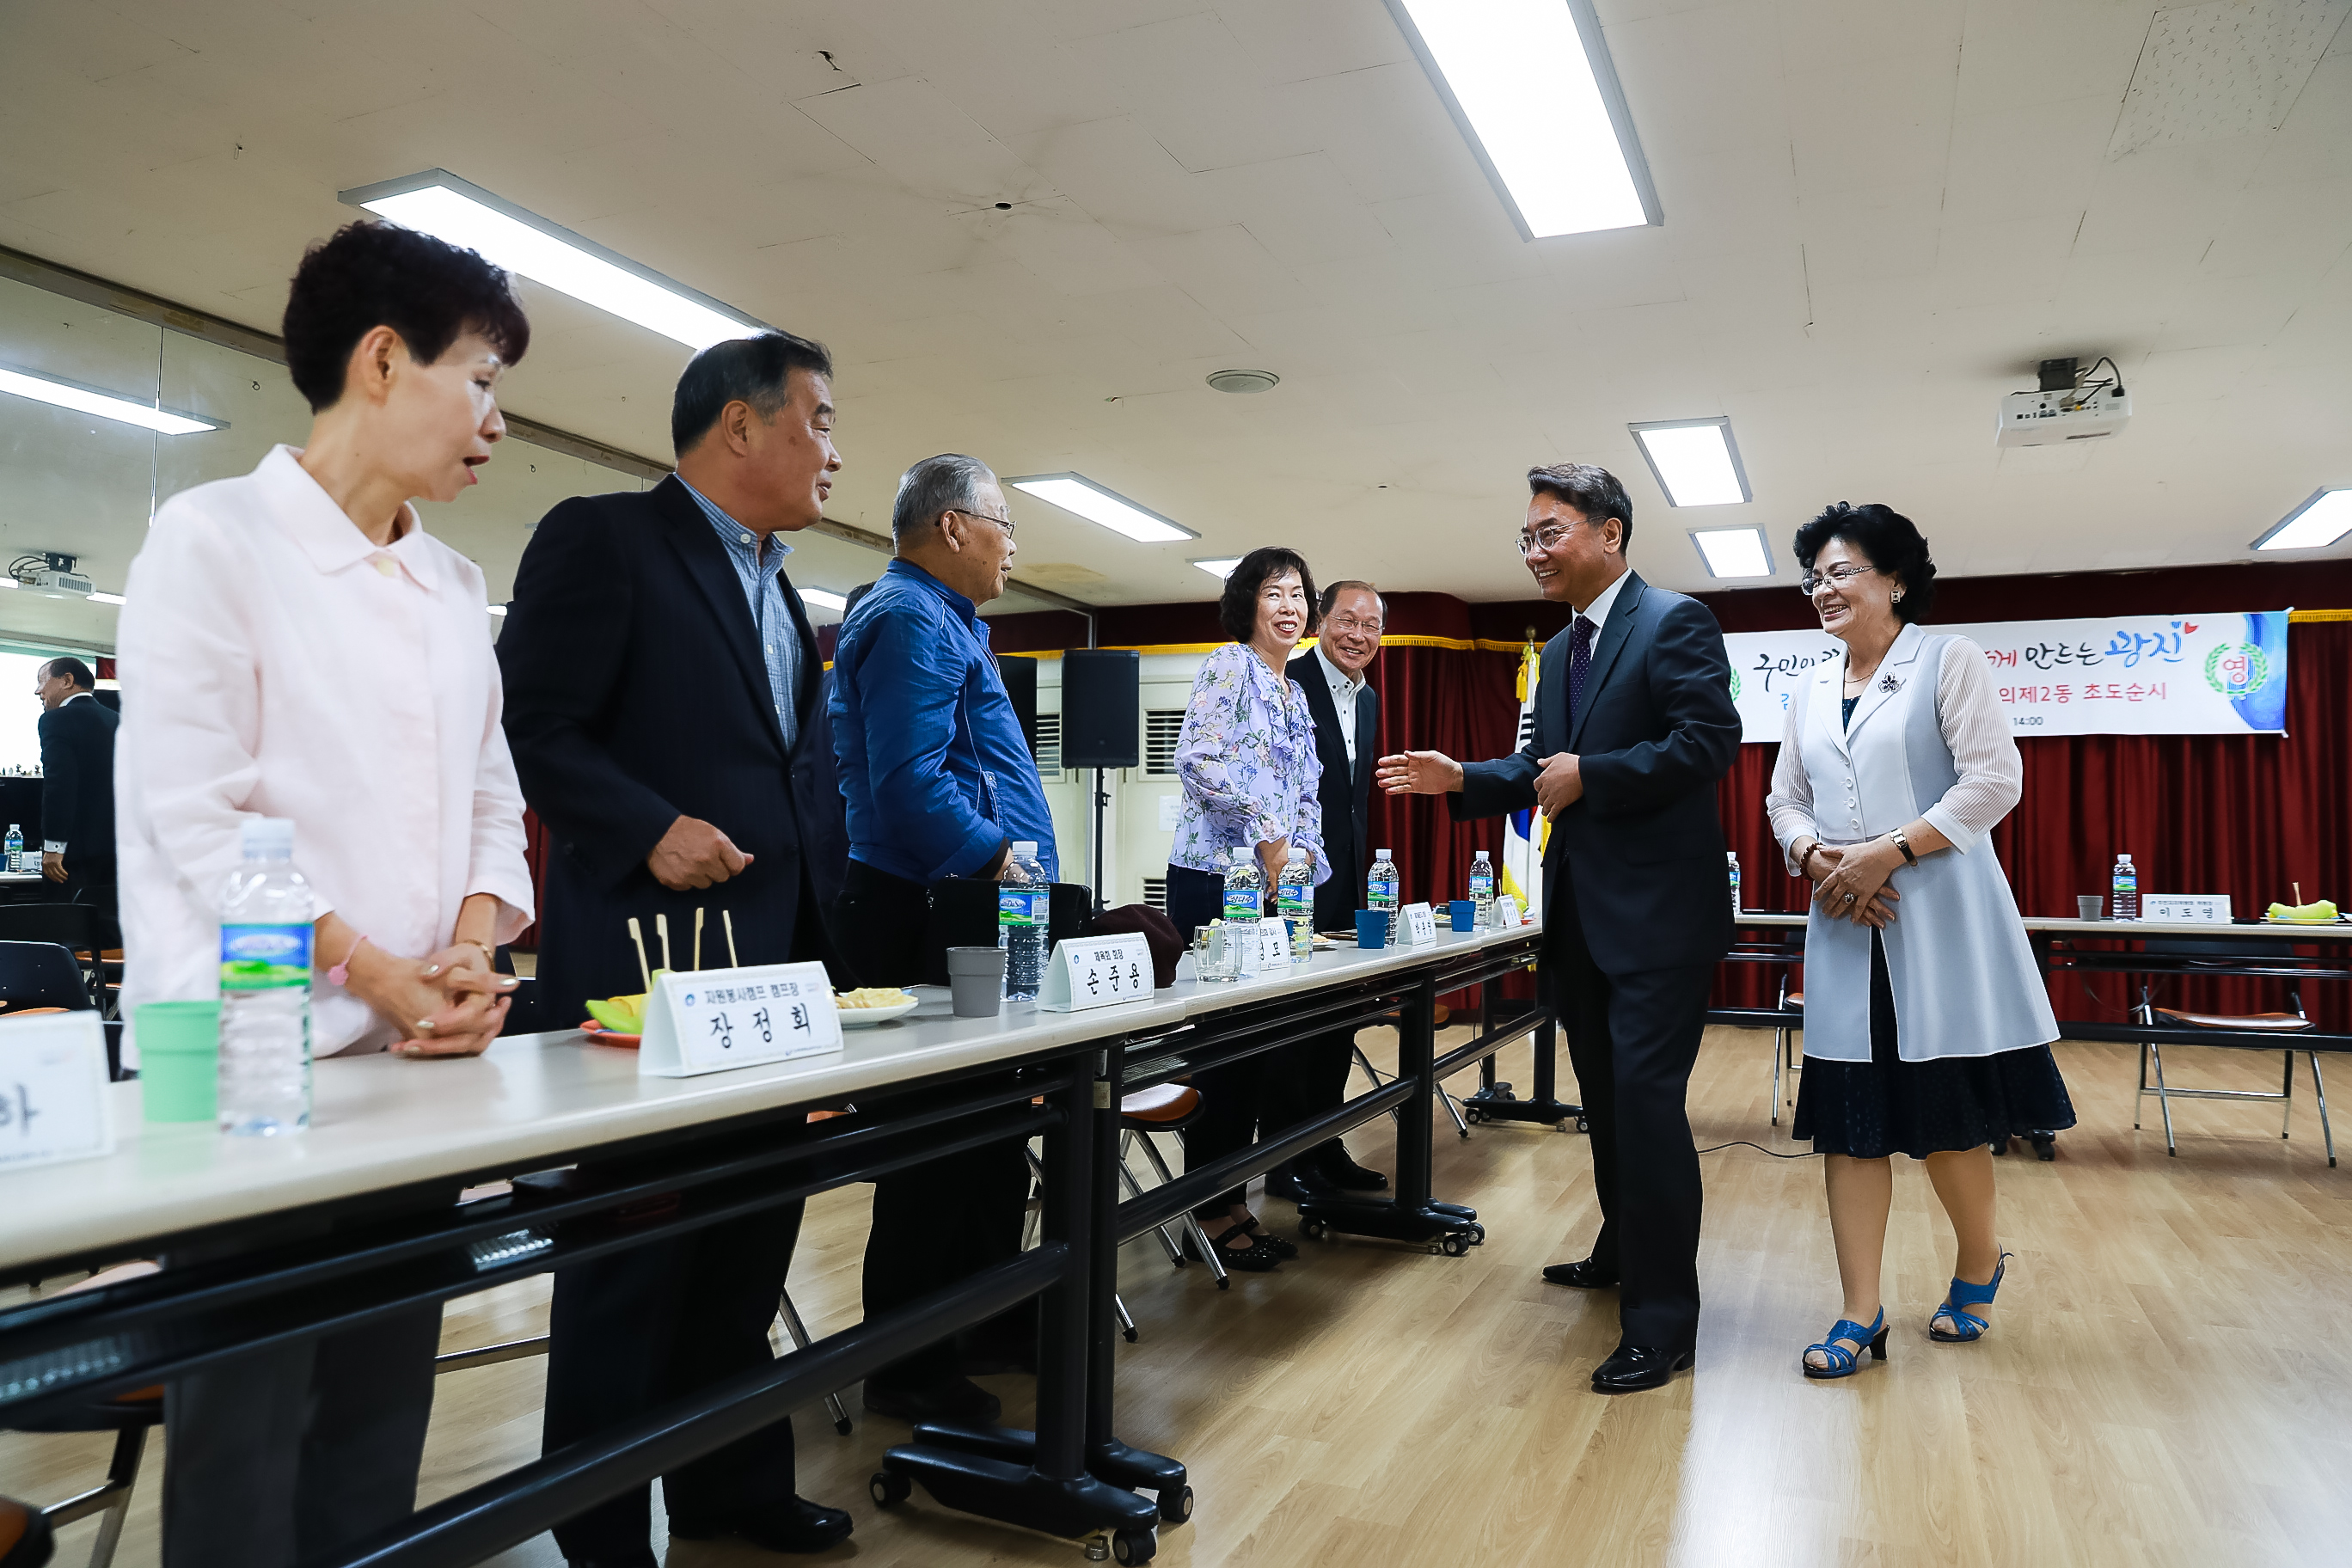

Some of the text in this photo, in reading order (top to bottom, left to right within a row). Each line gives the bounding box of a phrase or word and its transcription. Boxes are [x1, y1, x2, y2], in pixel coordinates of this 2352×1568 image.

[1984, 649, 2017, 668] 께
[2025, 642, 2104, 670] 만드는
[2104, 621, 2184, 668] 광진
[2223, 656, 2246, 683] 영
[2083, 683, 2166, 701] 초도순시
[2012, 716, 2043, 726] 14:00
[1094, 948, 1124, 962] 체육회 회장
[1087, 963, 1140, 995] 손준용
